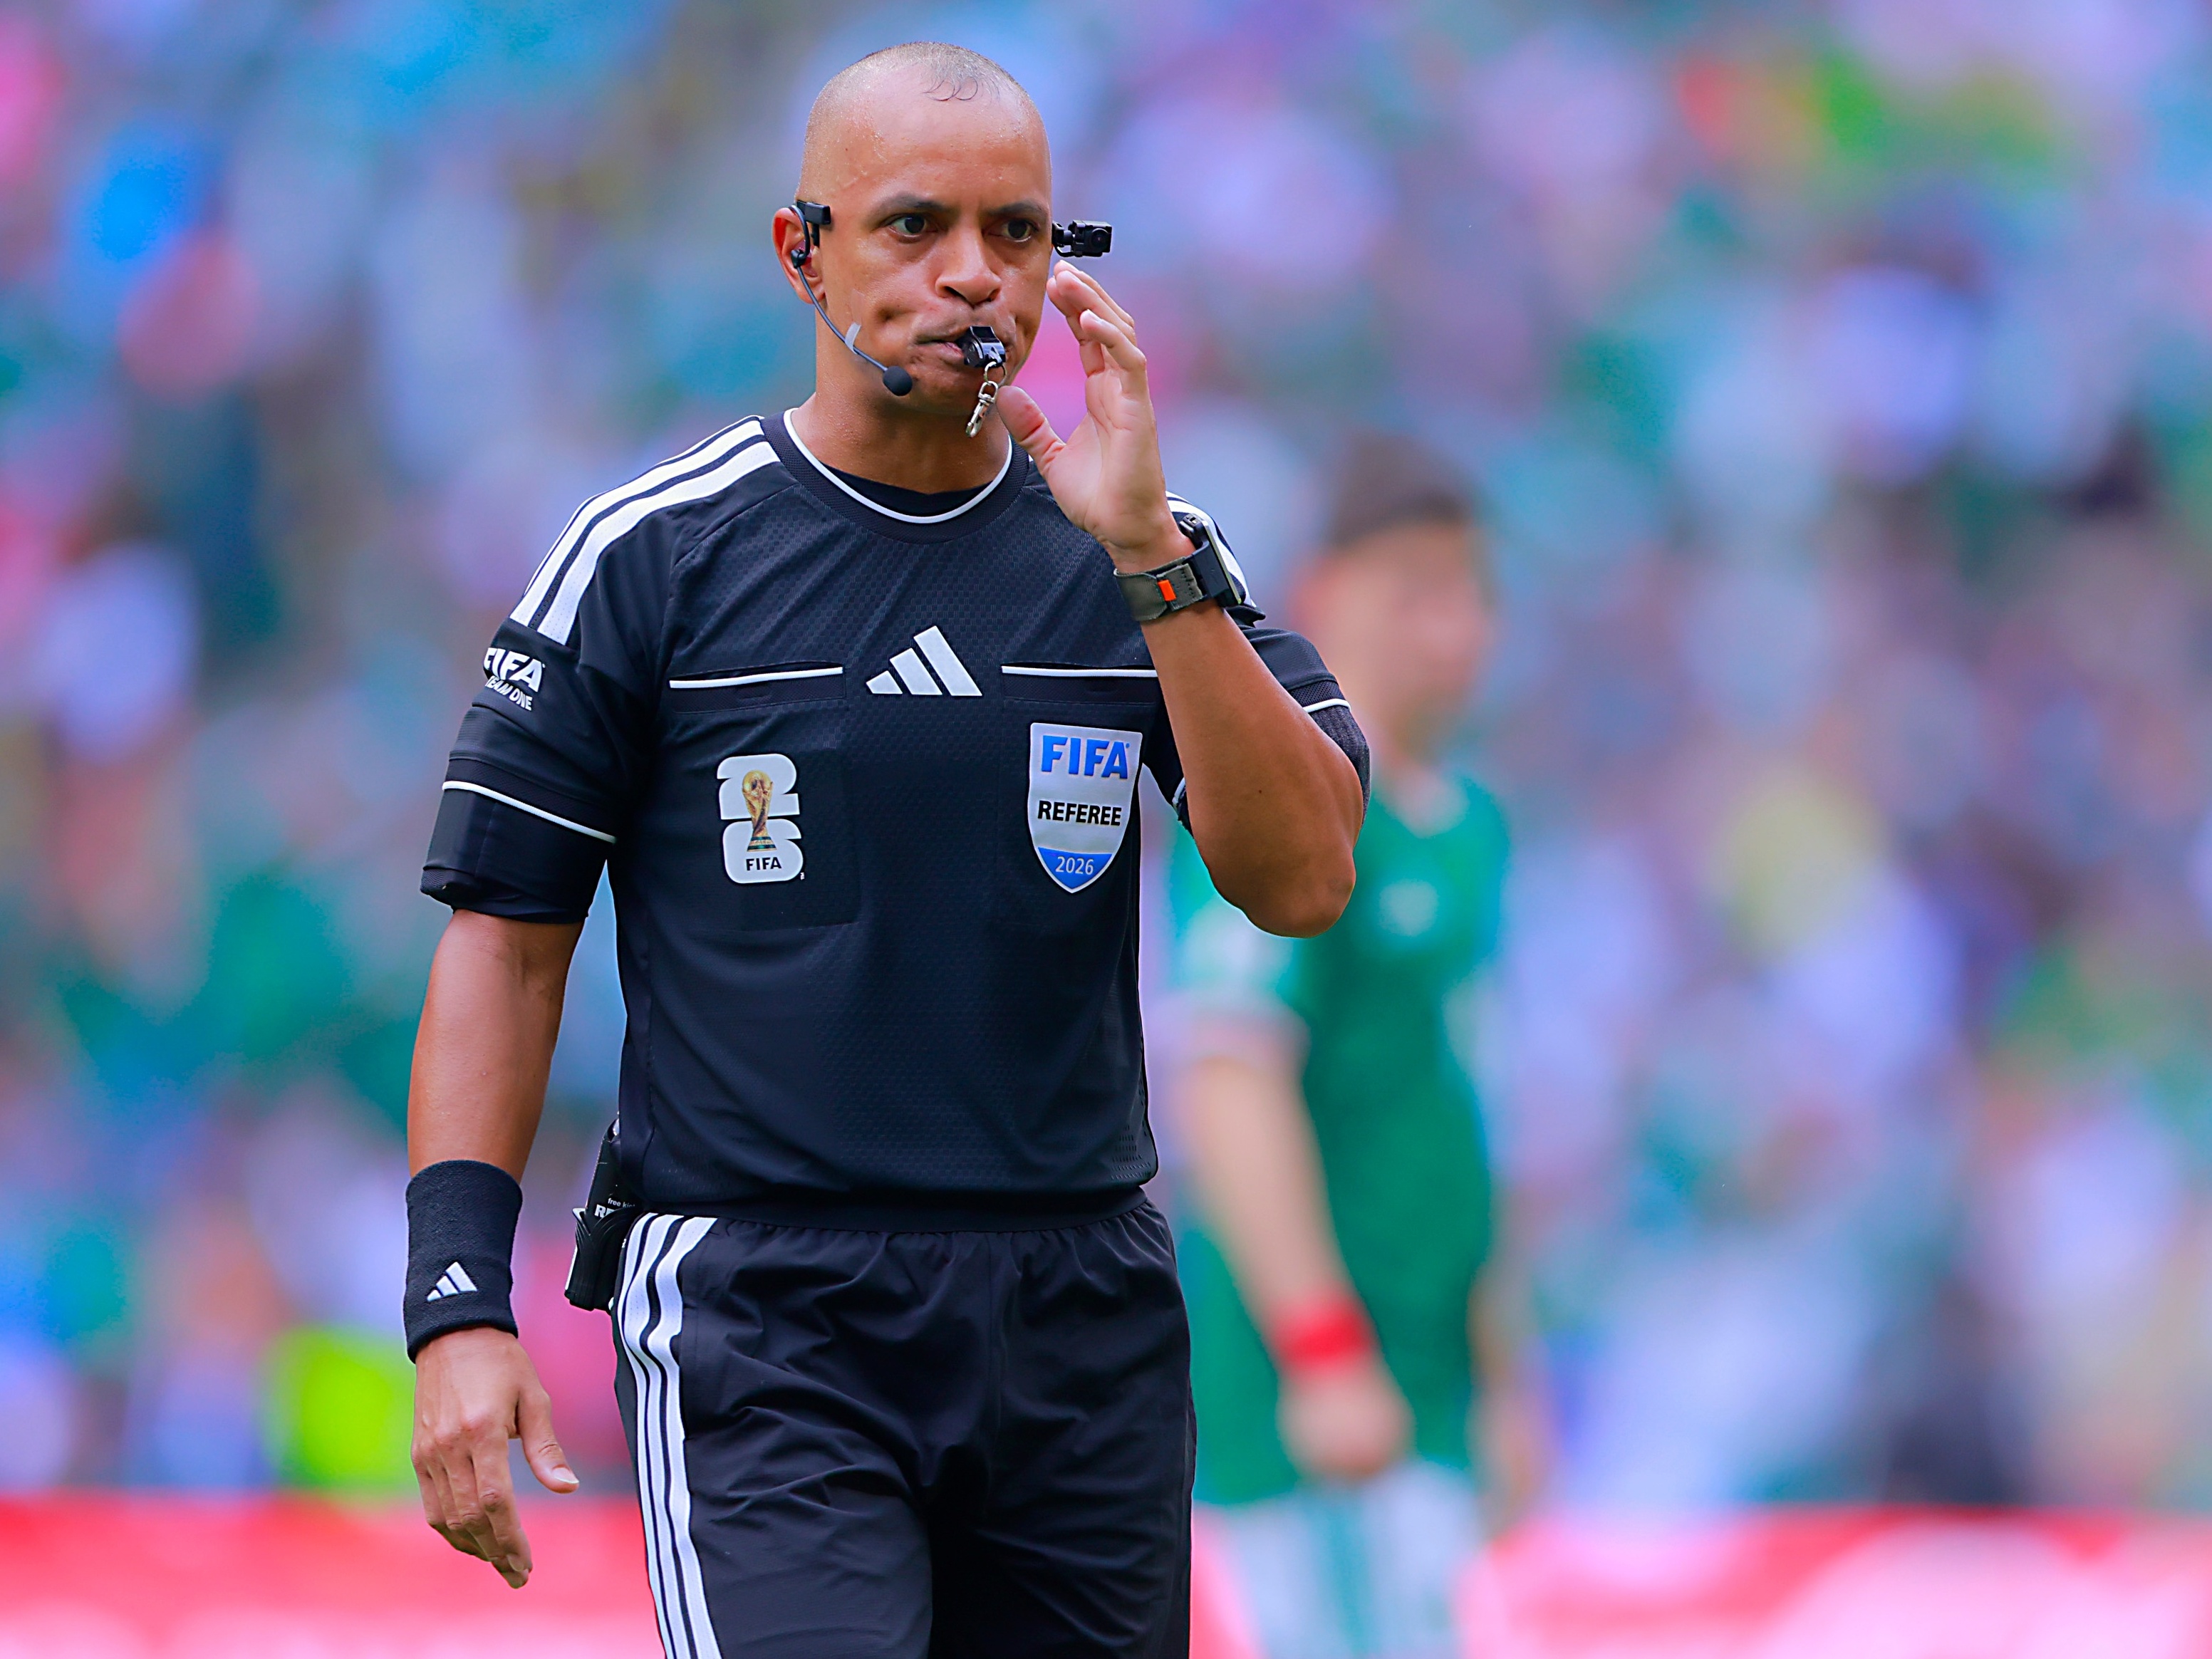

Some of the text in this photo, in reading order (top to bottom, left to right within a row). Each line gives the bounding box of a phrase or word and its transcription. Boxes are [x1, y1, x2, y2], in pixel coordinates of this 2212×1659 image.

[484, 648, 542, 692] FIFA
[485, 675, 533, 711] TEAM ONE
[1042, 735, 1128, 779] FIFA
[1037, 800, 1122, 826] REFEREE
[746, 857, 782, 870] FIFA
[1055, 856, 1094, 875] 2026
[608, 1197, 621, 1207] free
